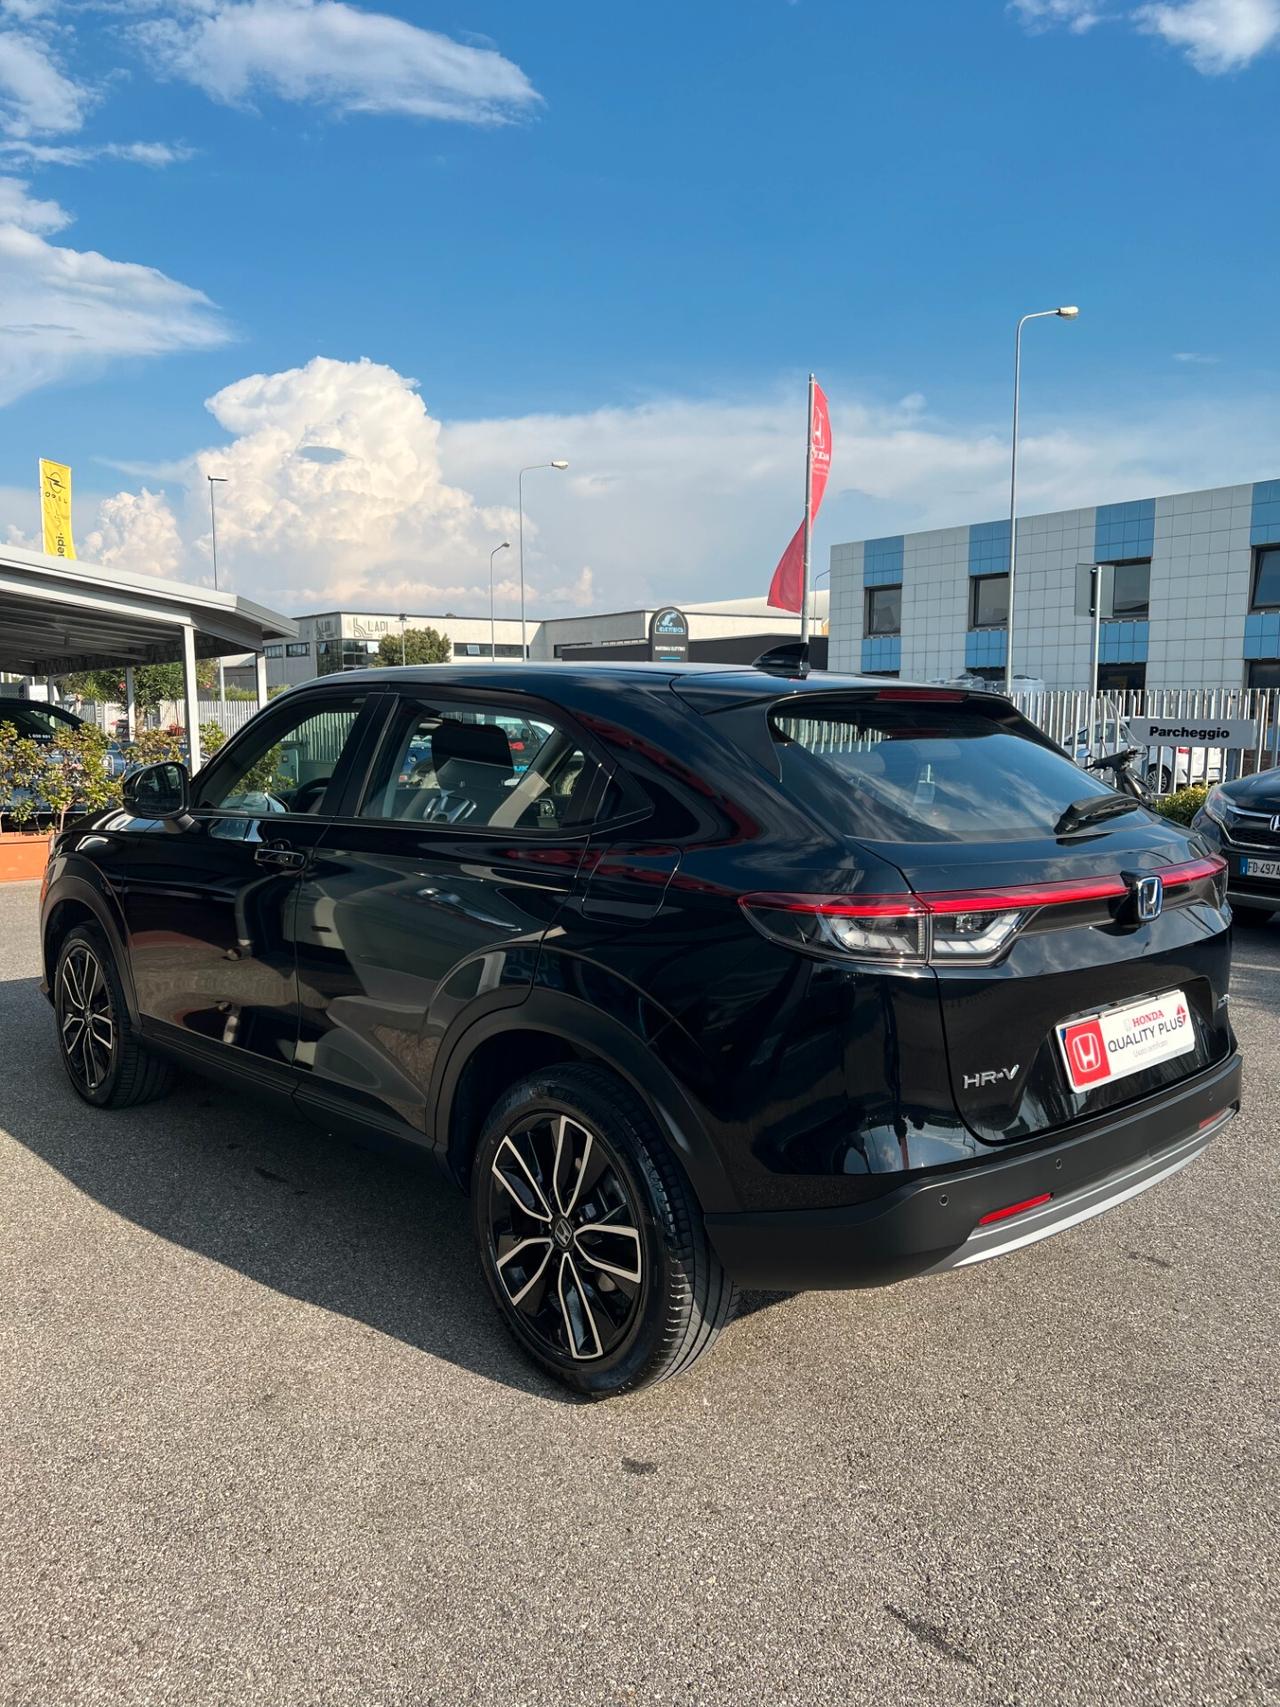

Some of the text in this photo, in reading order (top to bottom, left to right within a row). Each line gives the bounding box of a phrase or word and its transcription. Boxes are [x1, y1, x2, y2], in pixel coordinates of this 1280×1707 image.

[1149, 726, 1230, 740] Parcheggio
[1132, 1010, 1165, 1027] HONDA
[1107, 1027, 1155, 1053] QUALITY
[1159, 1016, 1184, 1035] PLUS
[962, 1063, 1020, 1089] HR-V
